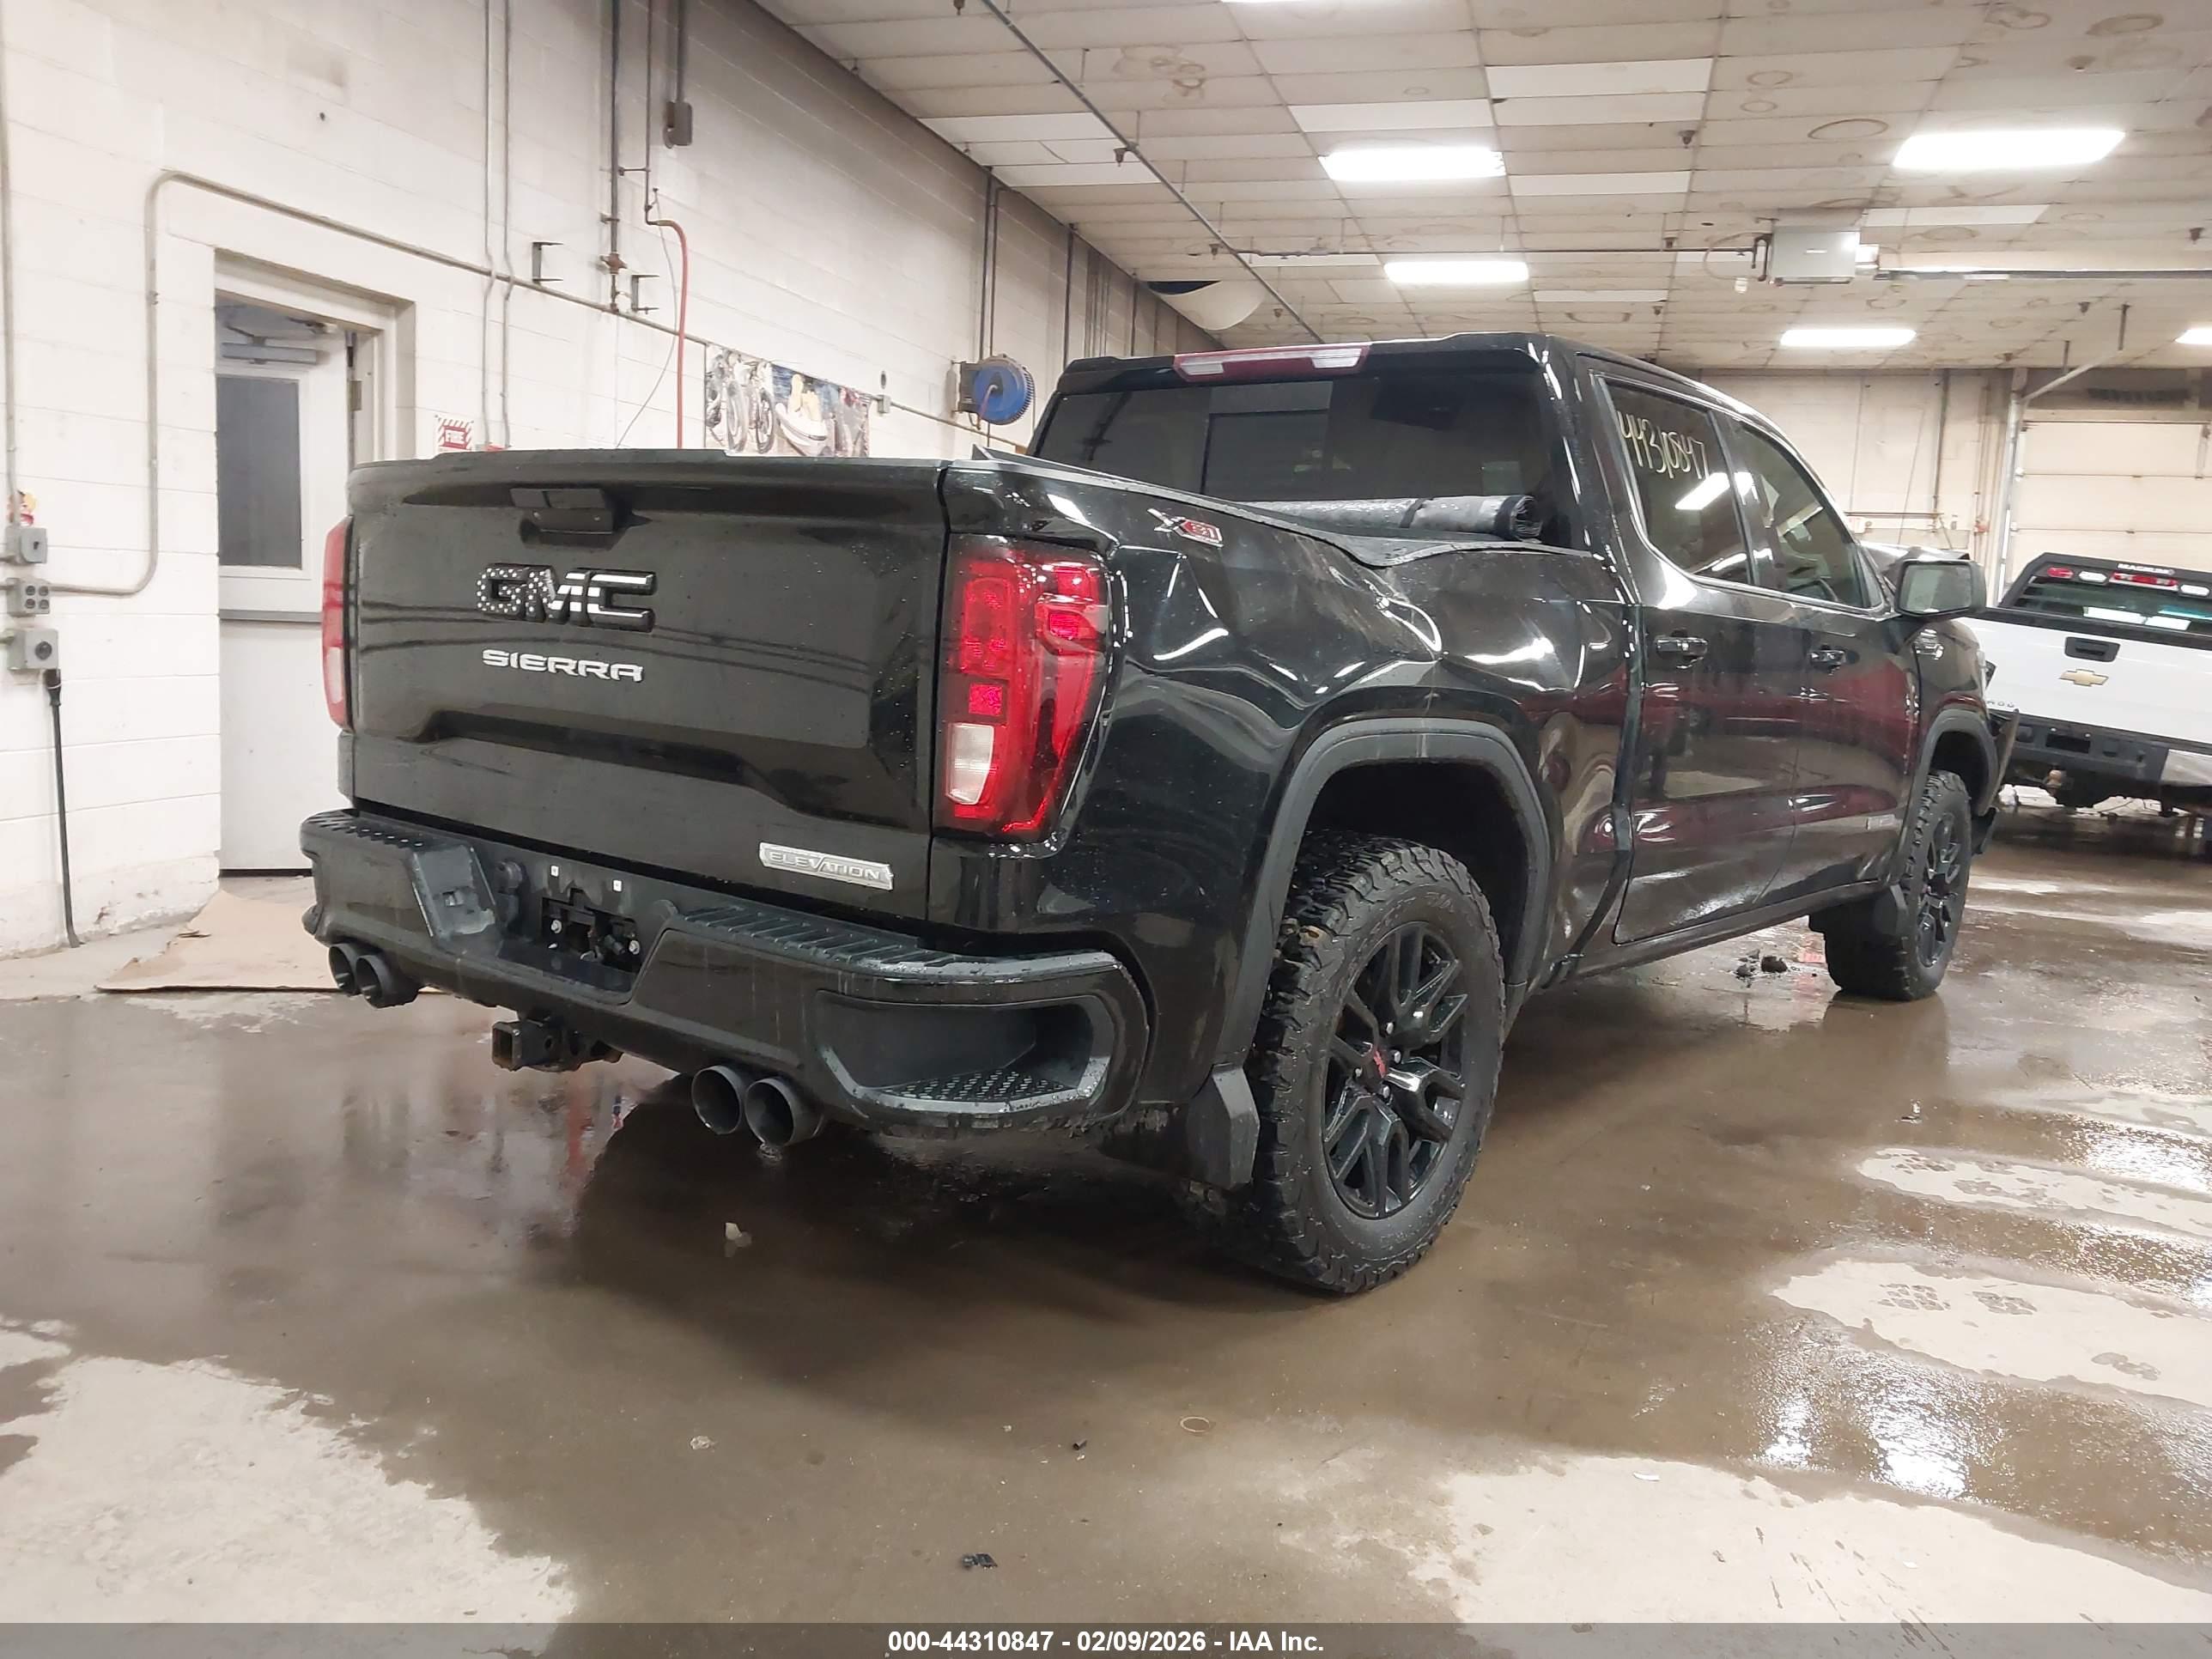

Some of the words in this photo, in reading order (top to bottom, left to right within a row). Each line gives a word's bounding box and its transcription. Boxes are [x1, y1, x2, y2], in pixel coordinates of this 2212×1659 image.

[1617, 410, 1710, 479] 44310847
[476, 563, 657, 633] GMC
[483, 649, 644, 683] SIERRA
[769, 851, 880, 880] ELEVATION
